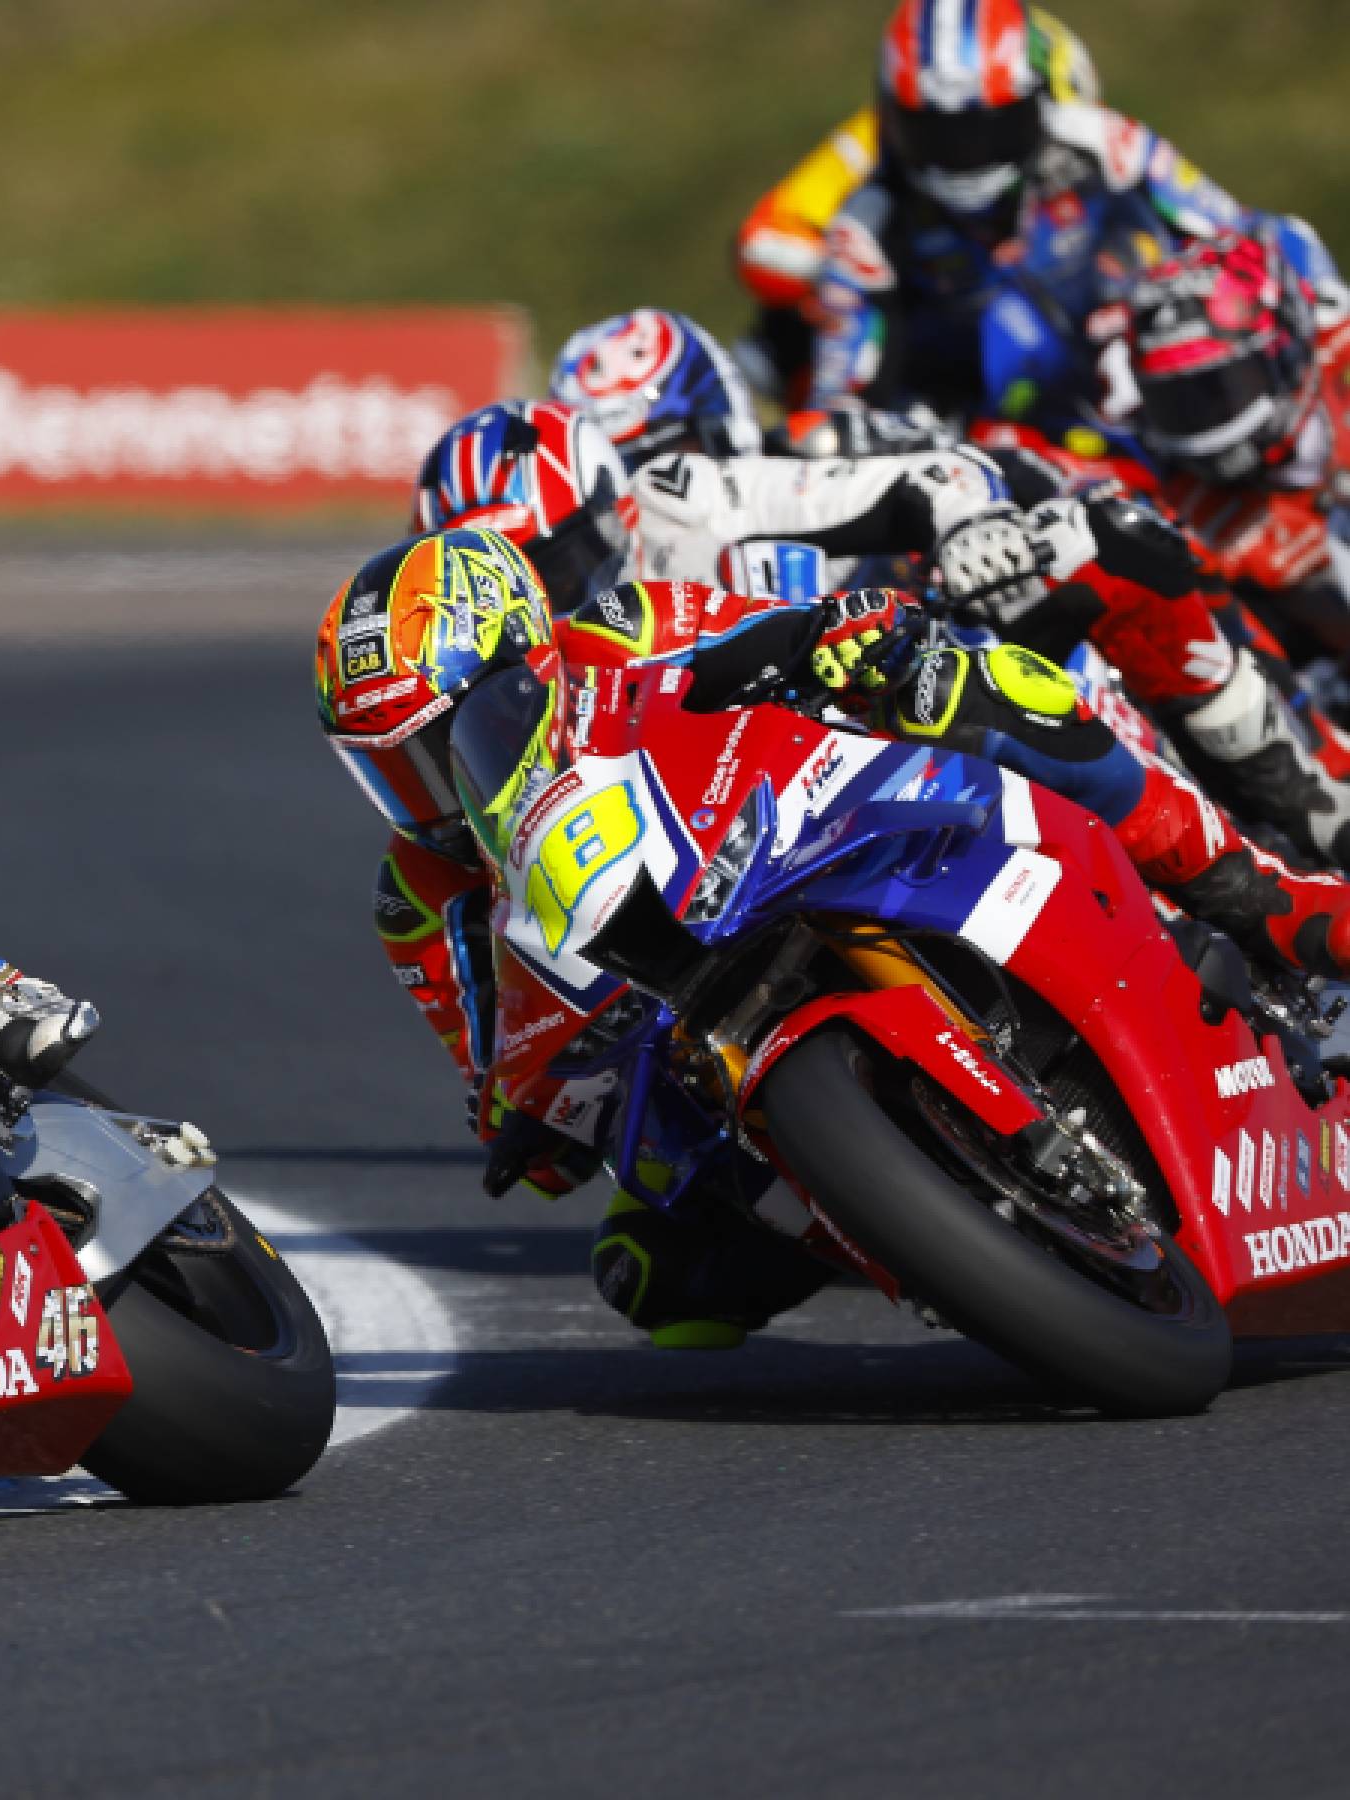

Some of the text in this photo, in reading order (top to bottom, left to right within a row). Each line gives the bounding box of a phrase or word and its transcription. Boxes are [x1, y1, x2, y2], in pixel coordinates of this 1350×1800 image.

[525, 779, 648, 960] 18
[1214, 1056, 1275, 1098] MOTUL
[35, 1284, 100, 1381] 46
